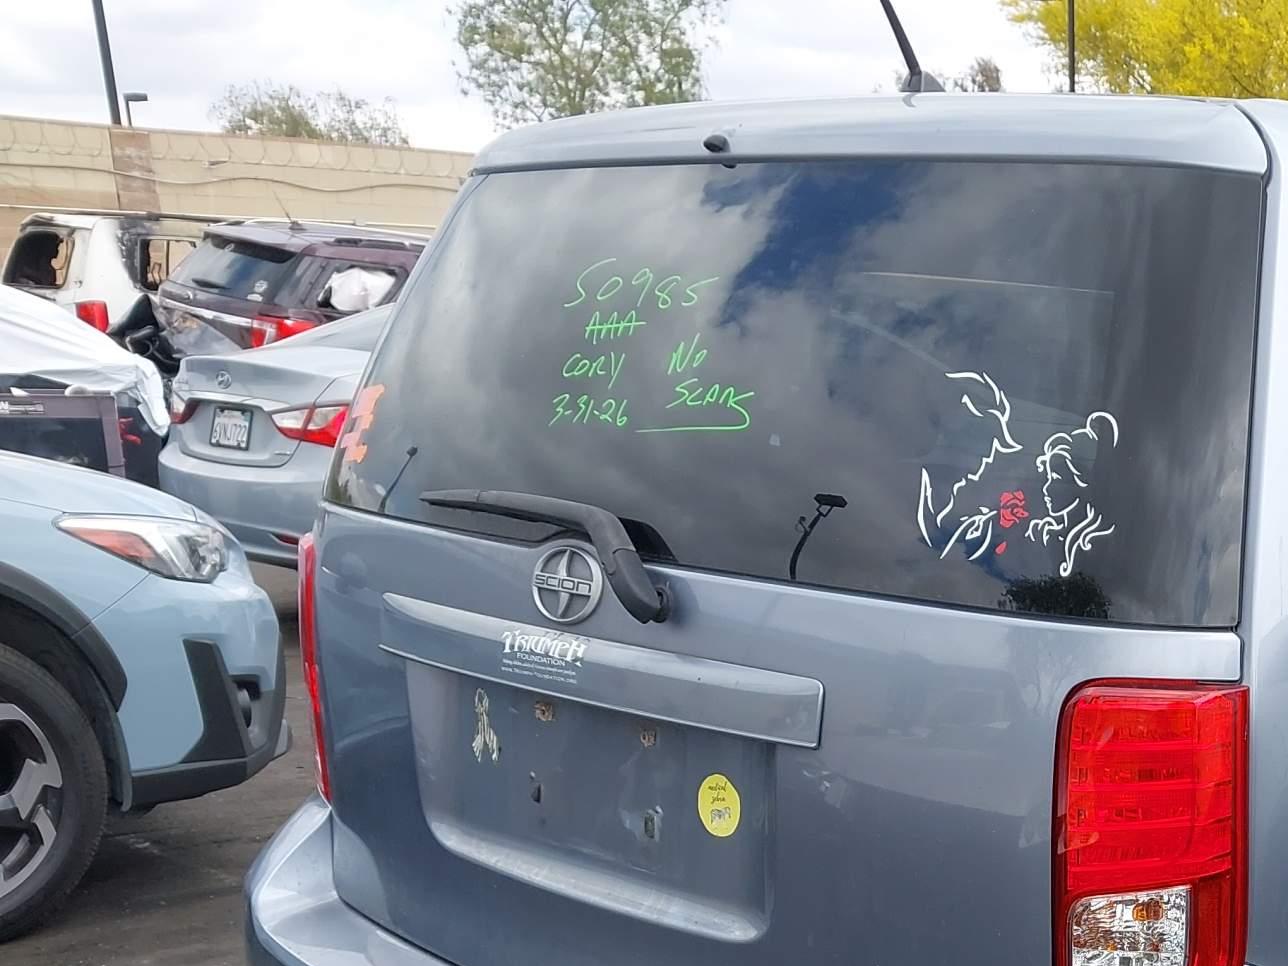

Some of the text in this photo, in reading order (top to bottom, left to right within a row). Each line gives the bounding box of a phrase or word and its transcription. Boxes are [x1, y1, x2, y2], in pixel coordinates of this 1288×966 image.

[563, 257, 720, 309] 50985
[584, 309, 647, 345] AAA
[548, 393, 628, 426] 3-31-26
[535, 573, 592, 595] SCION
[501, 630, 587, 663] TRIUMPH
[516, 652, 566, 667] FOUNDATION
